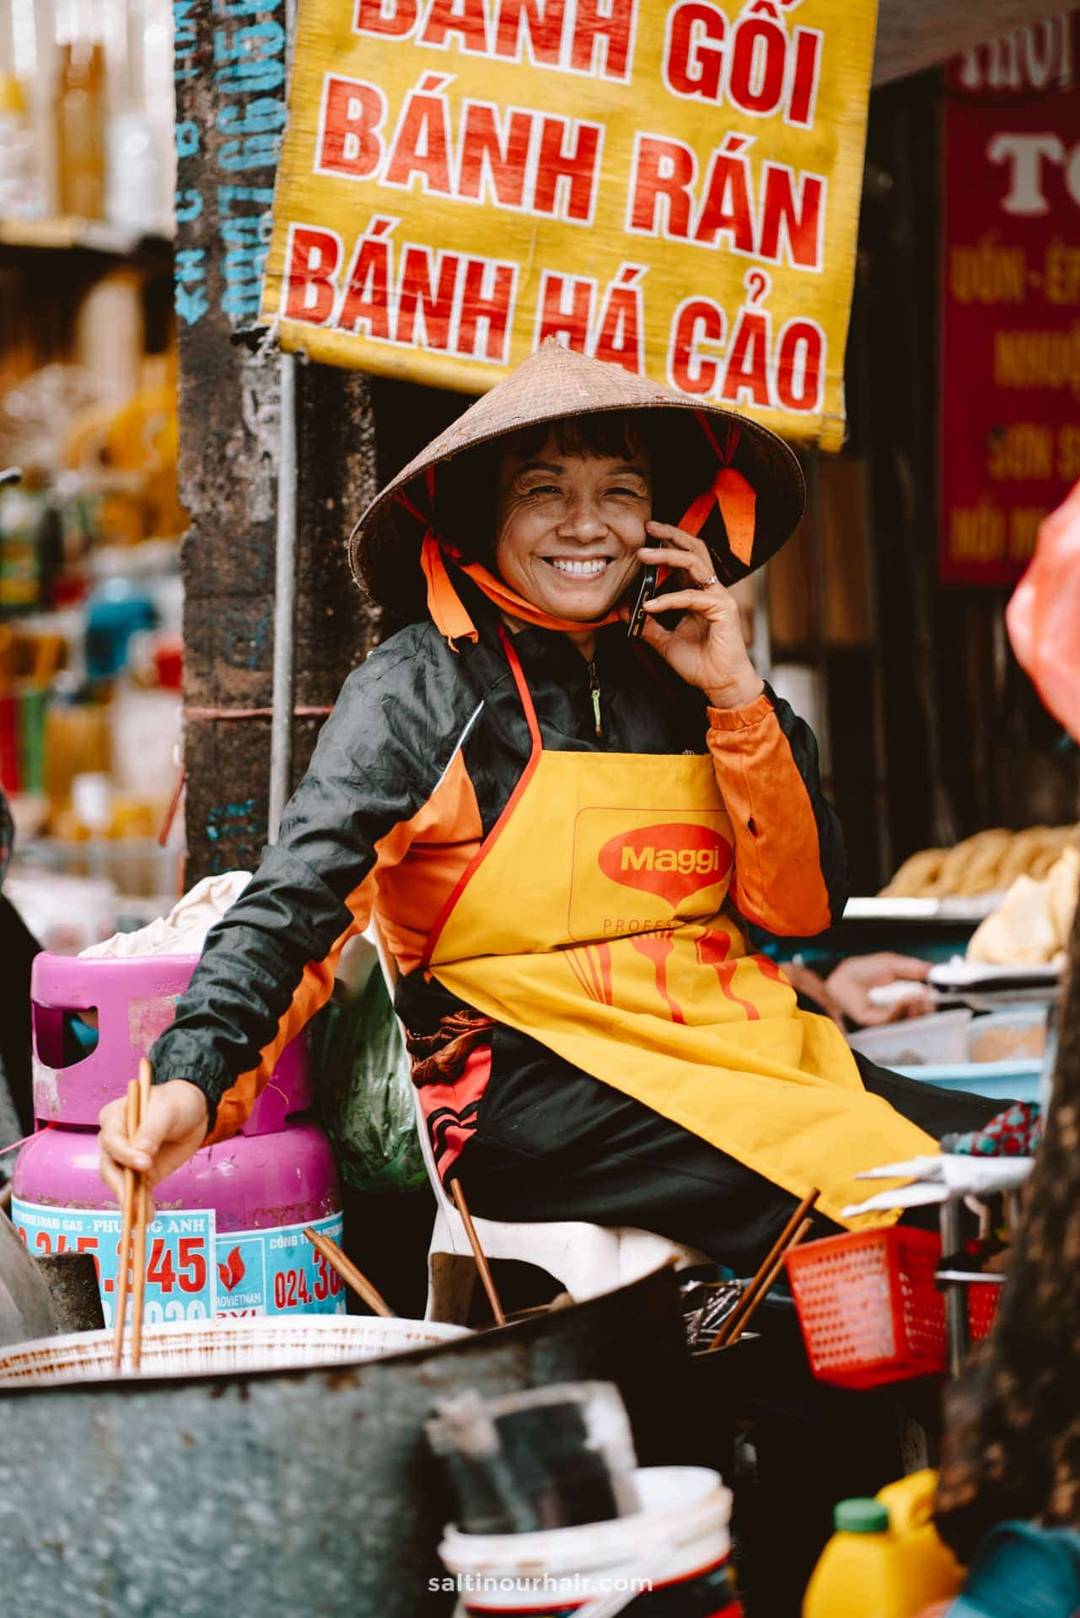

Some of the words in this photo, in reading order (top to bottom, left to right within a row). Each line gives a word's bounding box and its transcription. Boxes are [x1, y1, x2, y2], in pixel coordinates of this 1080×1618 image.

[664, 0, 820, 126] GỐI
[317, 74, 603, 224] BÁNH
[628, 134, 825, 269] RÁN
[284, 217, 518, 361] BÁNH
[537, 264, 644, 375] HÁ
[670, 271, 826, 412] CẢO
[620, 845, 719, 875] Maggi
[167, 1218, 205, 1233] ANH
